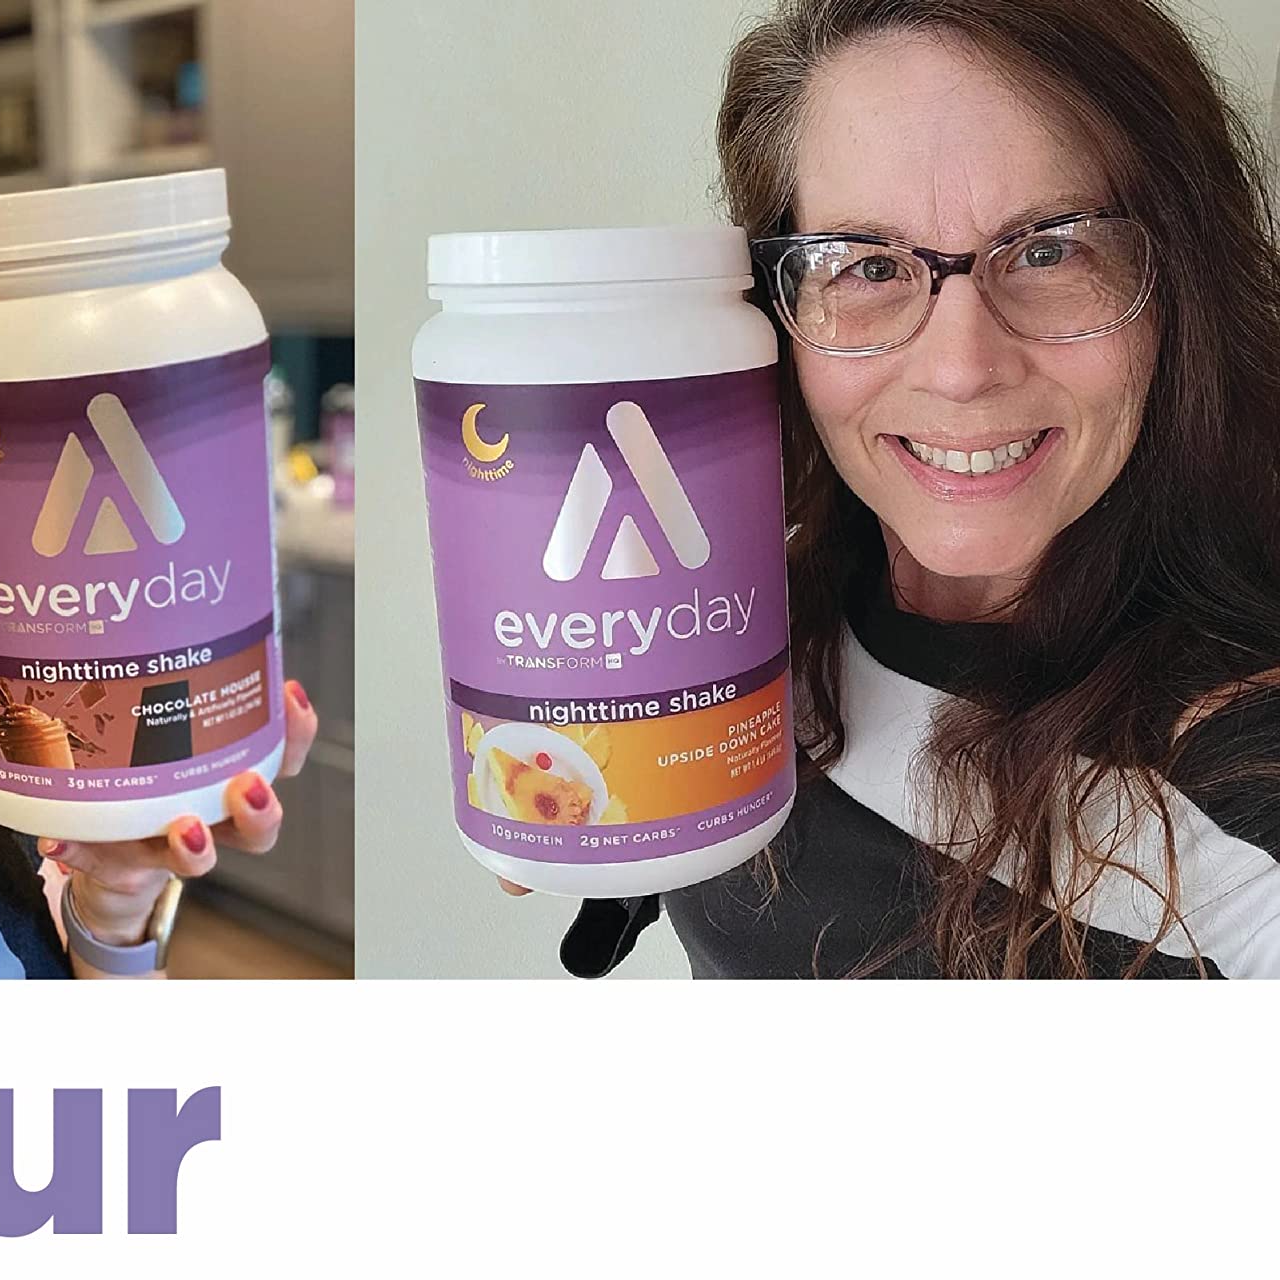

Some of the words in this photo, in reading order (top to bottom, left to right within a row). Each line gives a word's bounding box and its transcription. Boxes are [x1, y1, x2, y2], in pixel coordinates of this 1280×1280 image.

[462, 456, 515, 482] nighttime
[0, 621, 88, 635] RANSFORM
[494, 586, 756, 656] everyday
[21, 660, 139, 683] nighttime
[146, 646, 213, 675] shake
[505, 654, 604, 669] TRANSFORM
[131, 690, 217, 717] CHOCOLATE
[529, 700, 660, 725] nighttime
[669, 683, 737, 713] shake
[146, 712, 188, 727] Naturally
[728, 701, 781, 737] PINEAPPLE
[657, 745, 714, 767] UPSIDE
[719, 731, 757, 754] DOWN
[760, 714, 781, 736] CAKE
[8, 771, 53, 786] PROTEIN
[173, 765, 209, 781] CURBS
[67, 777, 85, 790] 3g
[87, 778, 110, 789] NET
[697, 813, 734, 831] CURBS
[491, 823, 512, 840] 10g
[513, 832, 563, 846] PROTEIN
[580, 835, 600, 848] 2g
[603, 835, 627, 846] NET
